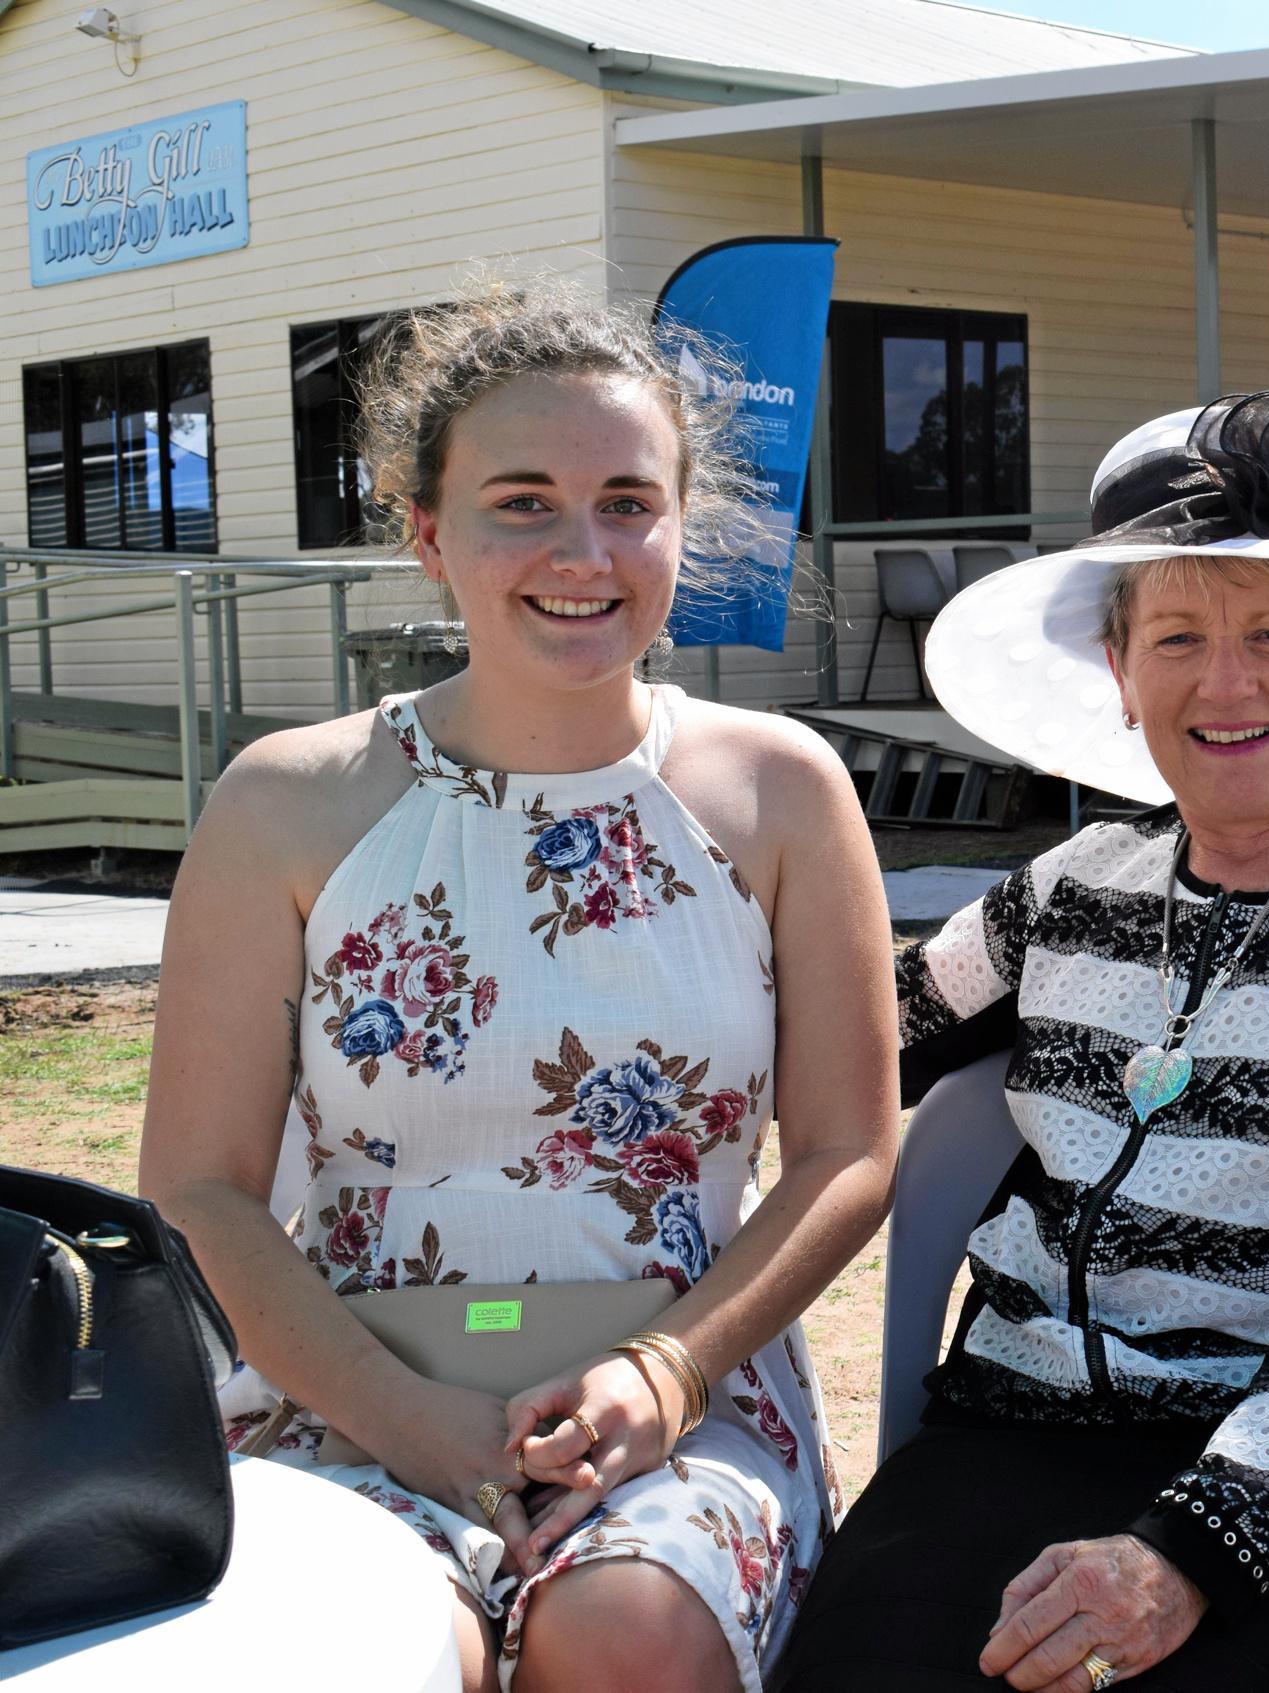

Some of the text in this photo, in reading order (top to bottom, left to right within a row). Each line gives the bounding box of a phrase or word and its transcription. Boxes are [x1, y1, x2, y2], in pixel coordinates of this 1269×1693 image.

[36, 146, 136, 264] Betty
[43, 188, 234, 263] LUNCHEON HALL
